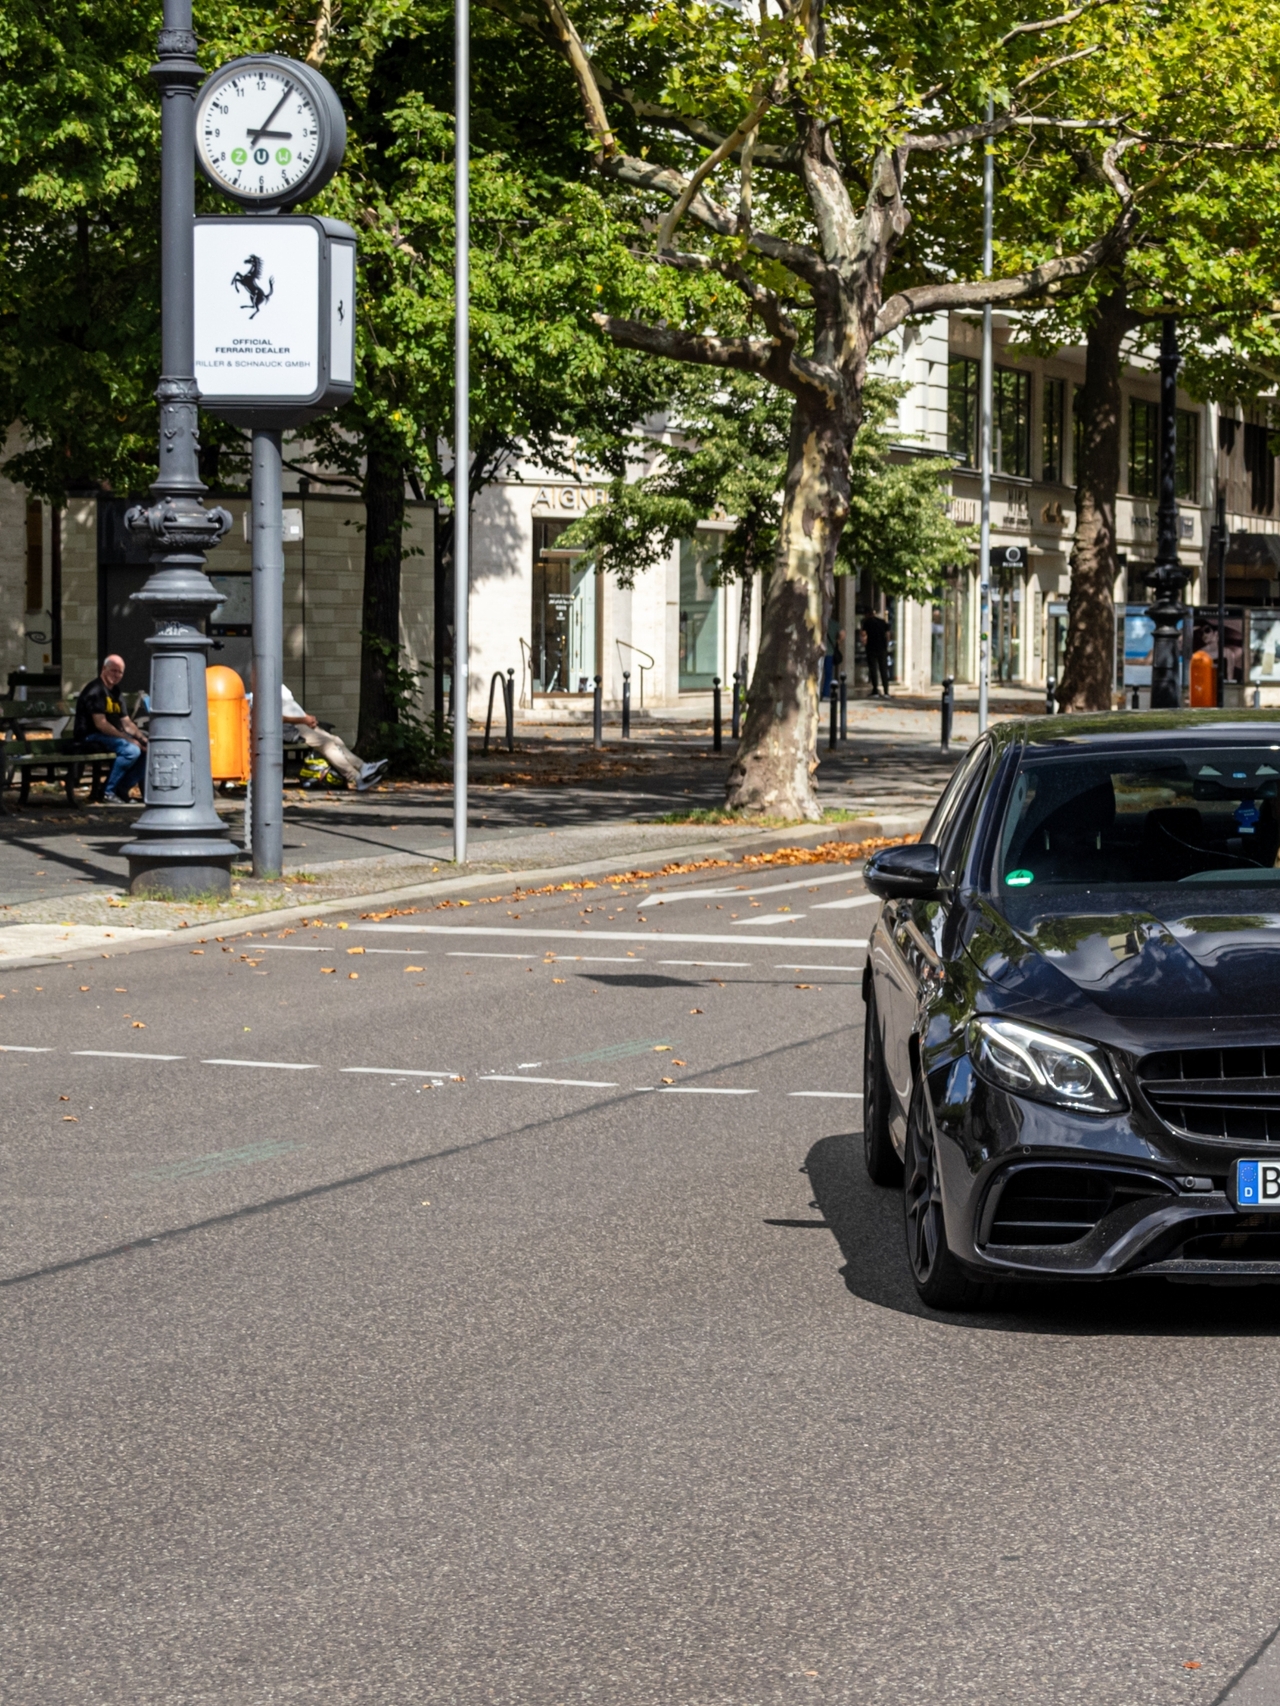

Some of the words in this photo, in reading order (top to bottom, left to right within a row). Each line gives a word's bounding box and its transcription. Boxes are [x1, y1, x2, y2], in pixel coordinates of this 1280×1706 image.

[257, 82, 266, 90] 12
[237, 88, 244, 97] 11
[219, 106, 229, 114] 10
[297, 105, 303, 114] 2
[215, 128, 220, 137] 9
[303, 128, 308, 137] 3
[220, 152, 226, 161] 8
[297, 152, 302, 160] 4
[237, 170, 242, 178] 7
[282, 170, 287, 178] 5
[259, 176, 264, 184] 6
[1244, 1187, 1253, 1197] D
